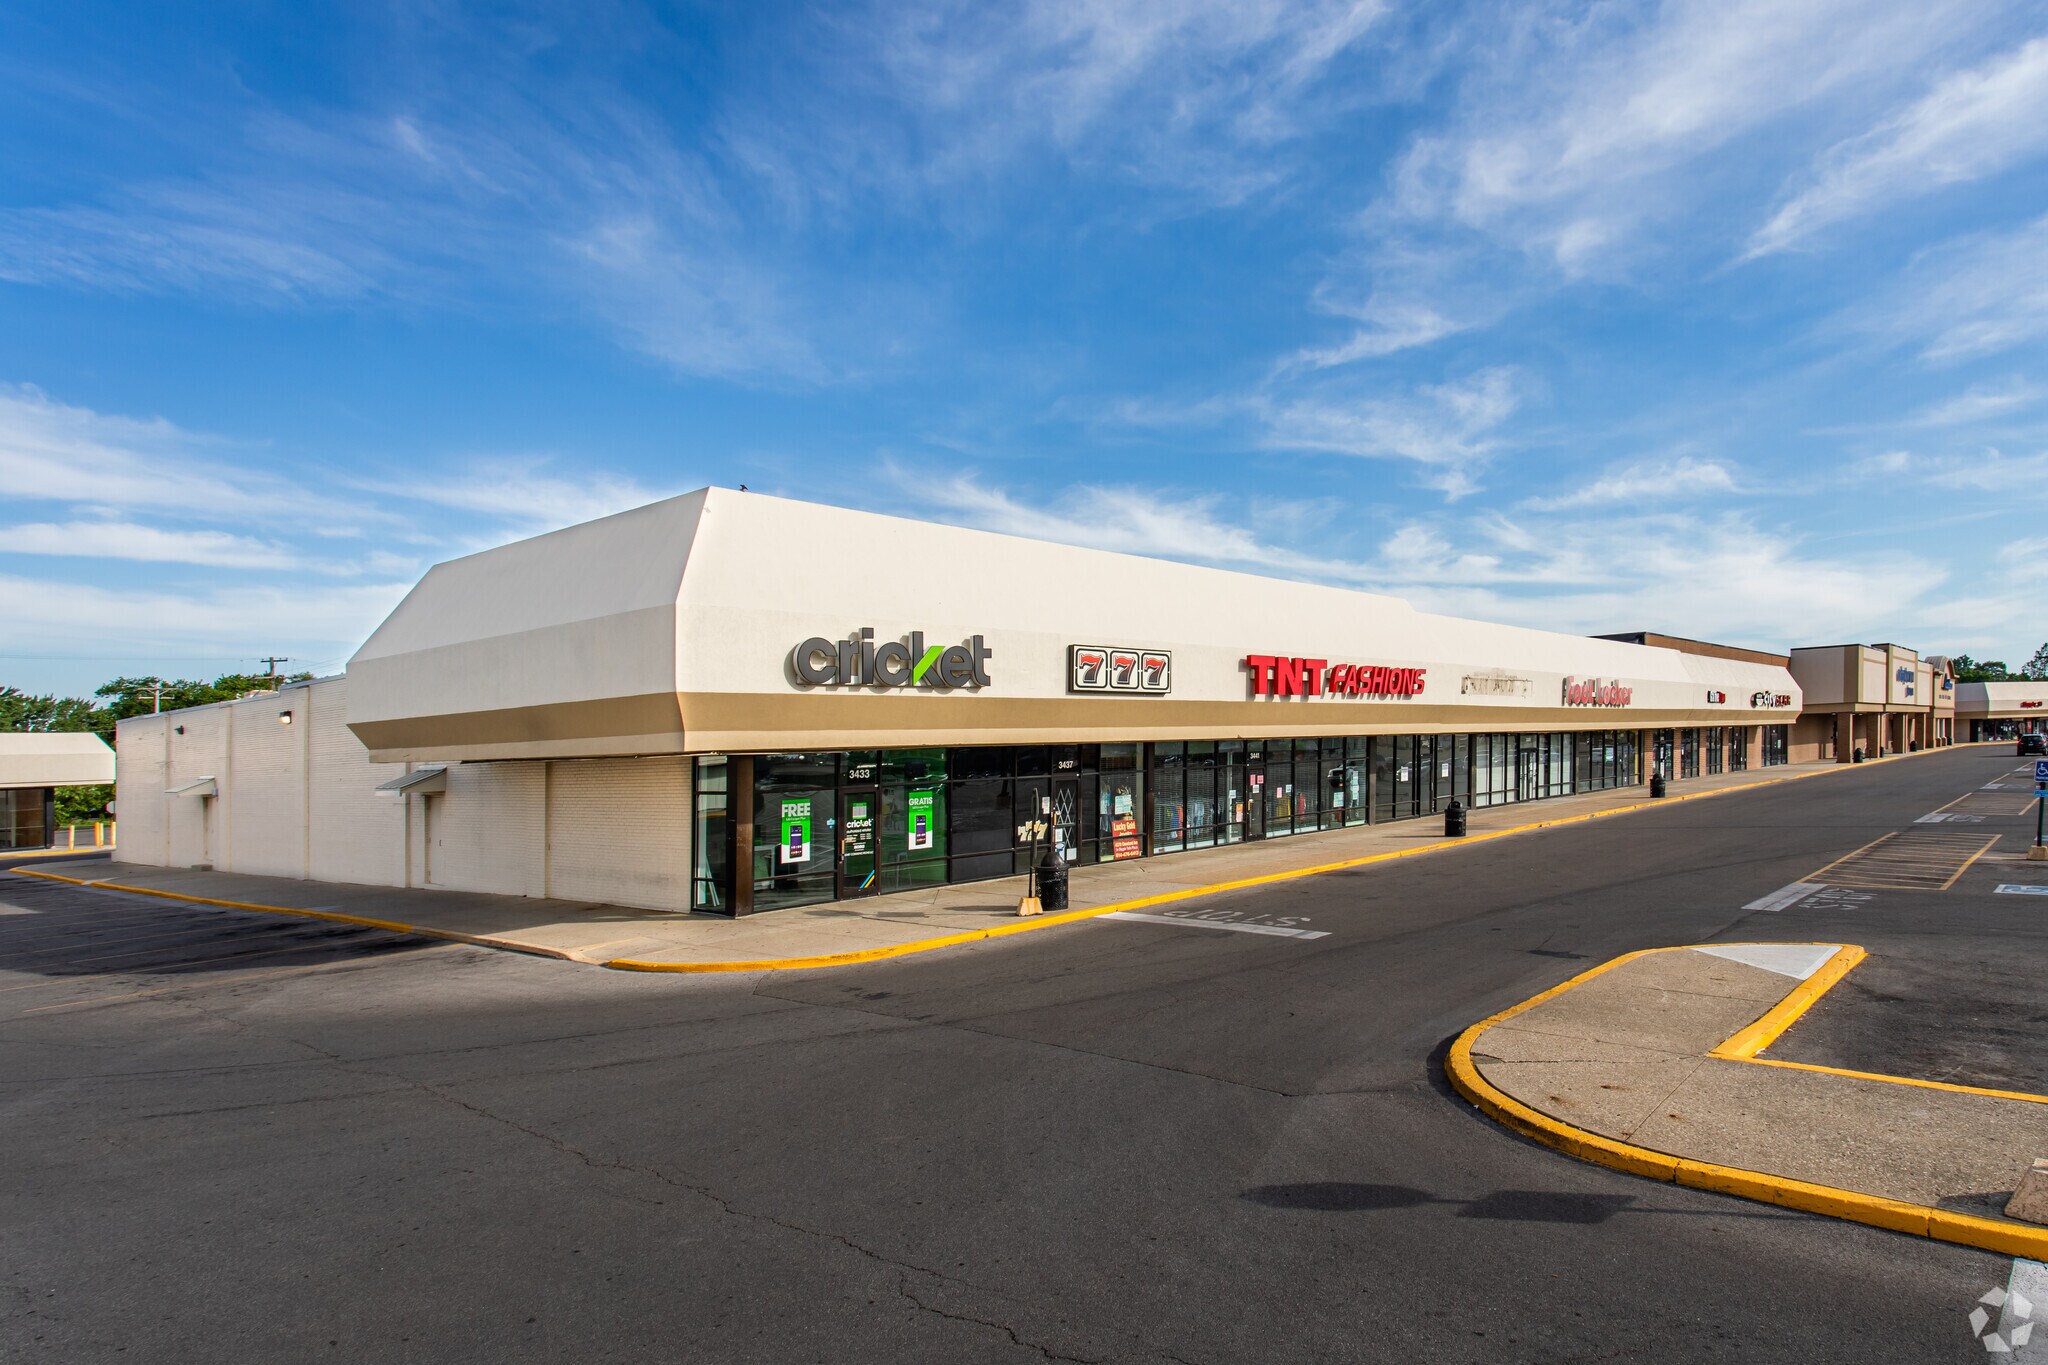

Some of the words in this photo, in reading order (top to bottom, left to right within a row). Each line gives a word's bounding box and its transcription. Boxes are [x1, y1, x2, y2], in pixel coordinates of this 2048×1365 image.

[795, 627, 993, 687] cricket
[1246, 655, 1328, 696] TNT
[1328, 663, 1427, 695] FASHIONS
[1566, 675, 1596, 705] Foot
[1596, 677, 1633, 706] Locker
[1058, 760, 1074, 770] 3437
[848, 769, 871, 779] 3433
[908, 796, 933, 806] GRATIS
[781, 802, 811, 818] FREE
[846, 818, 872, 828] cricket
[1113, 823, 1126, 831] Lucky
[1126, 821, 1136, 830] Gold
